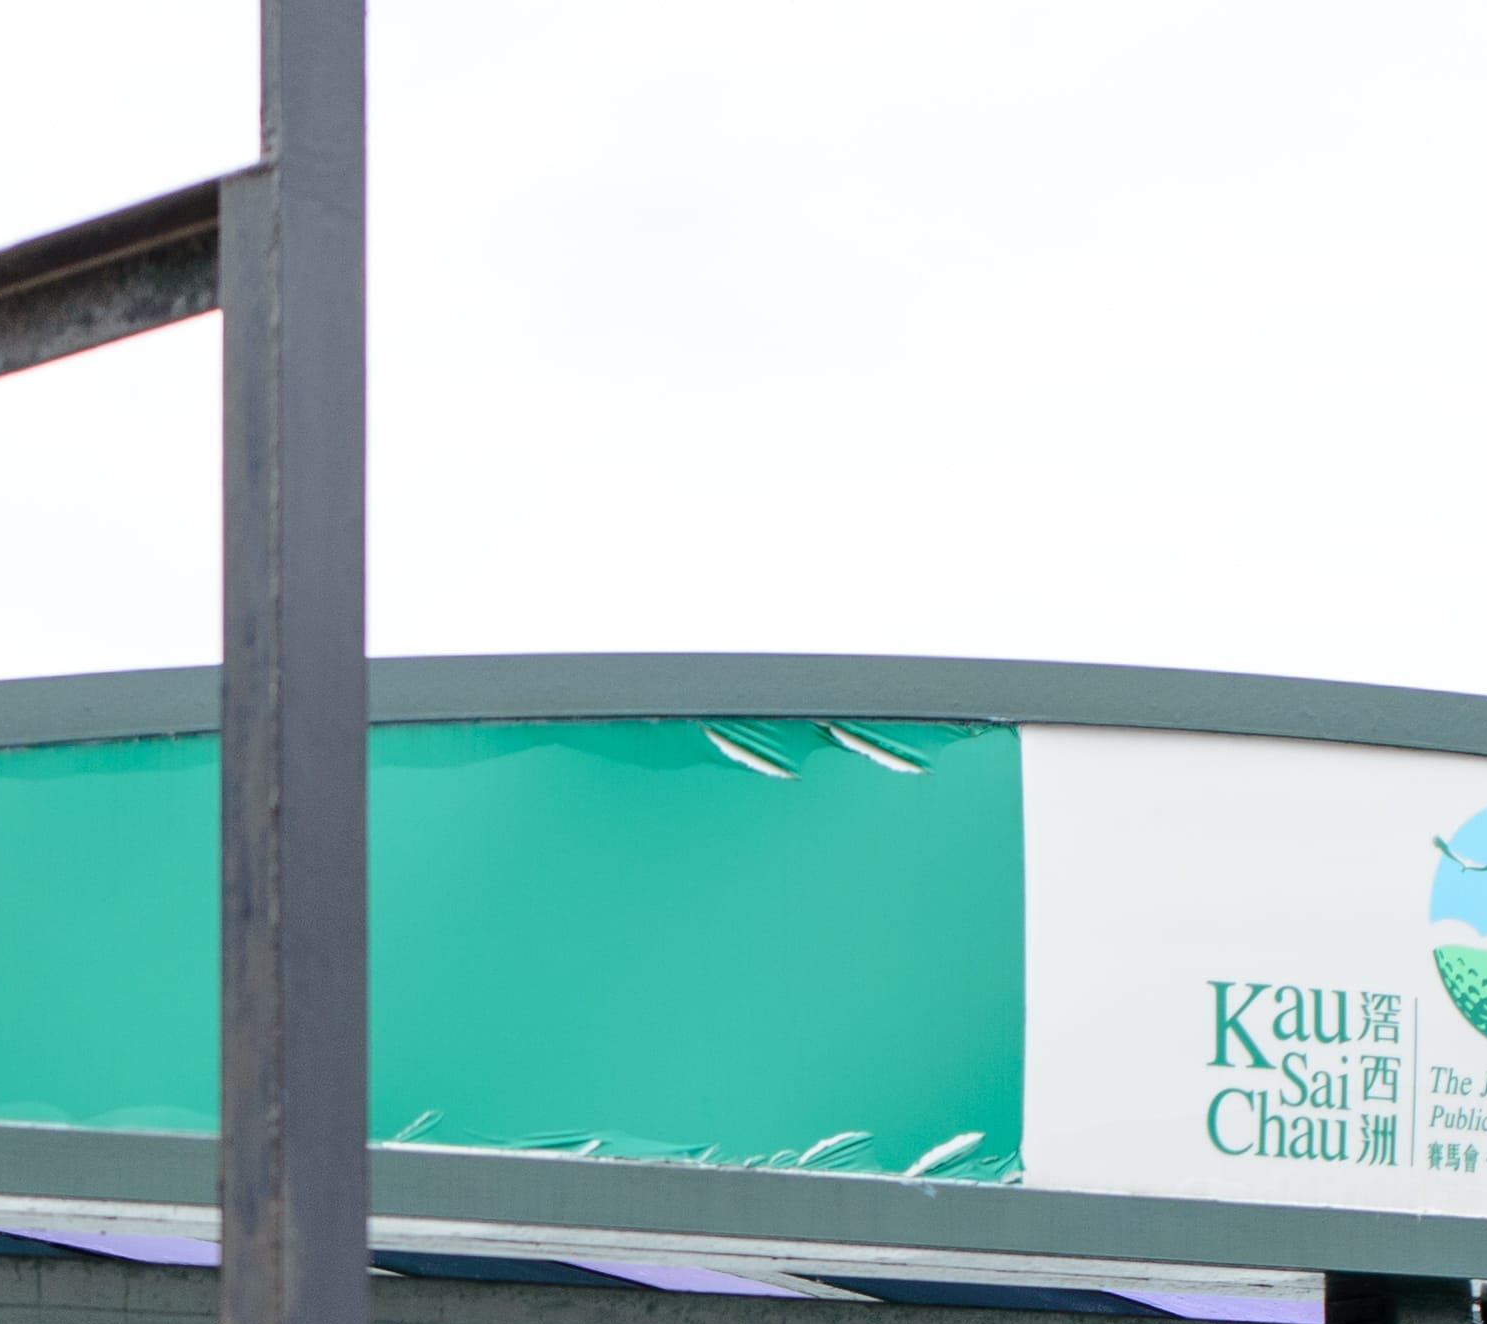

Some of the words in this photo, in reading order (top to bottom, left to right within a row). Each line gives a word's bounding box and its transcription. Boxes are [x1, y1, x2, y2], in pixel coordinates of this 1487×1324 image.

[1205, 980, 1352, 1070] Kau
[1279, 1051, 1351, 1111] Sai
[1356, 991, 1402, 1167] 滘西洲
[1430, 1065, 1473, 1096] The
[1206, 1087, 1349, 1162] Chau
